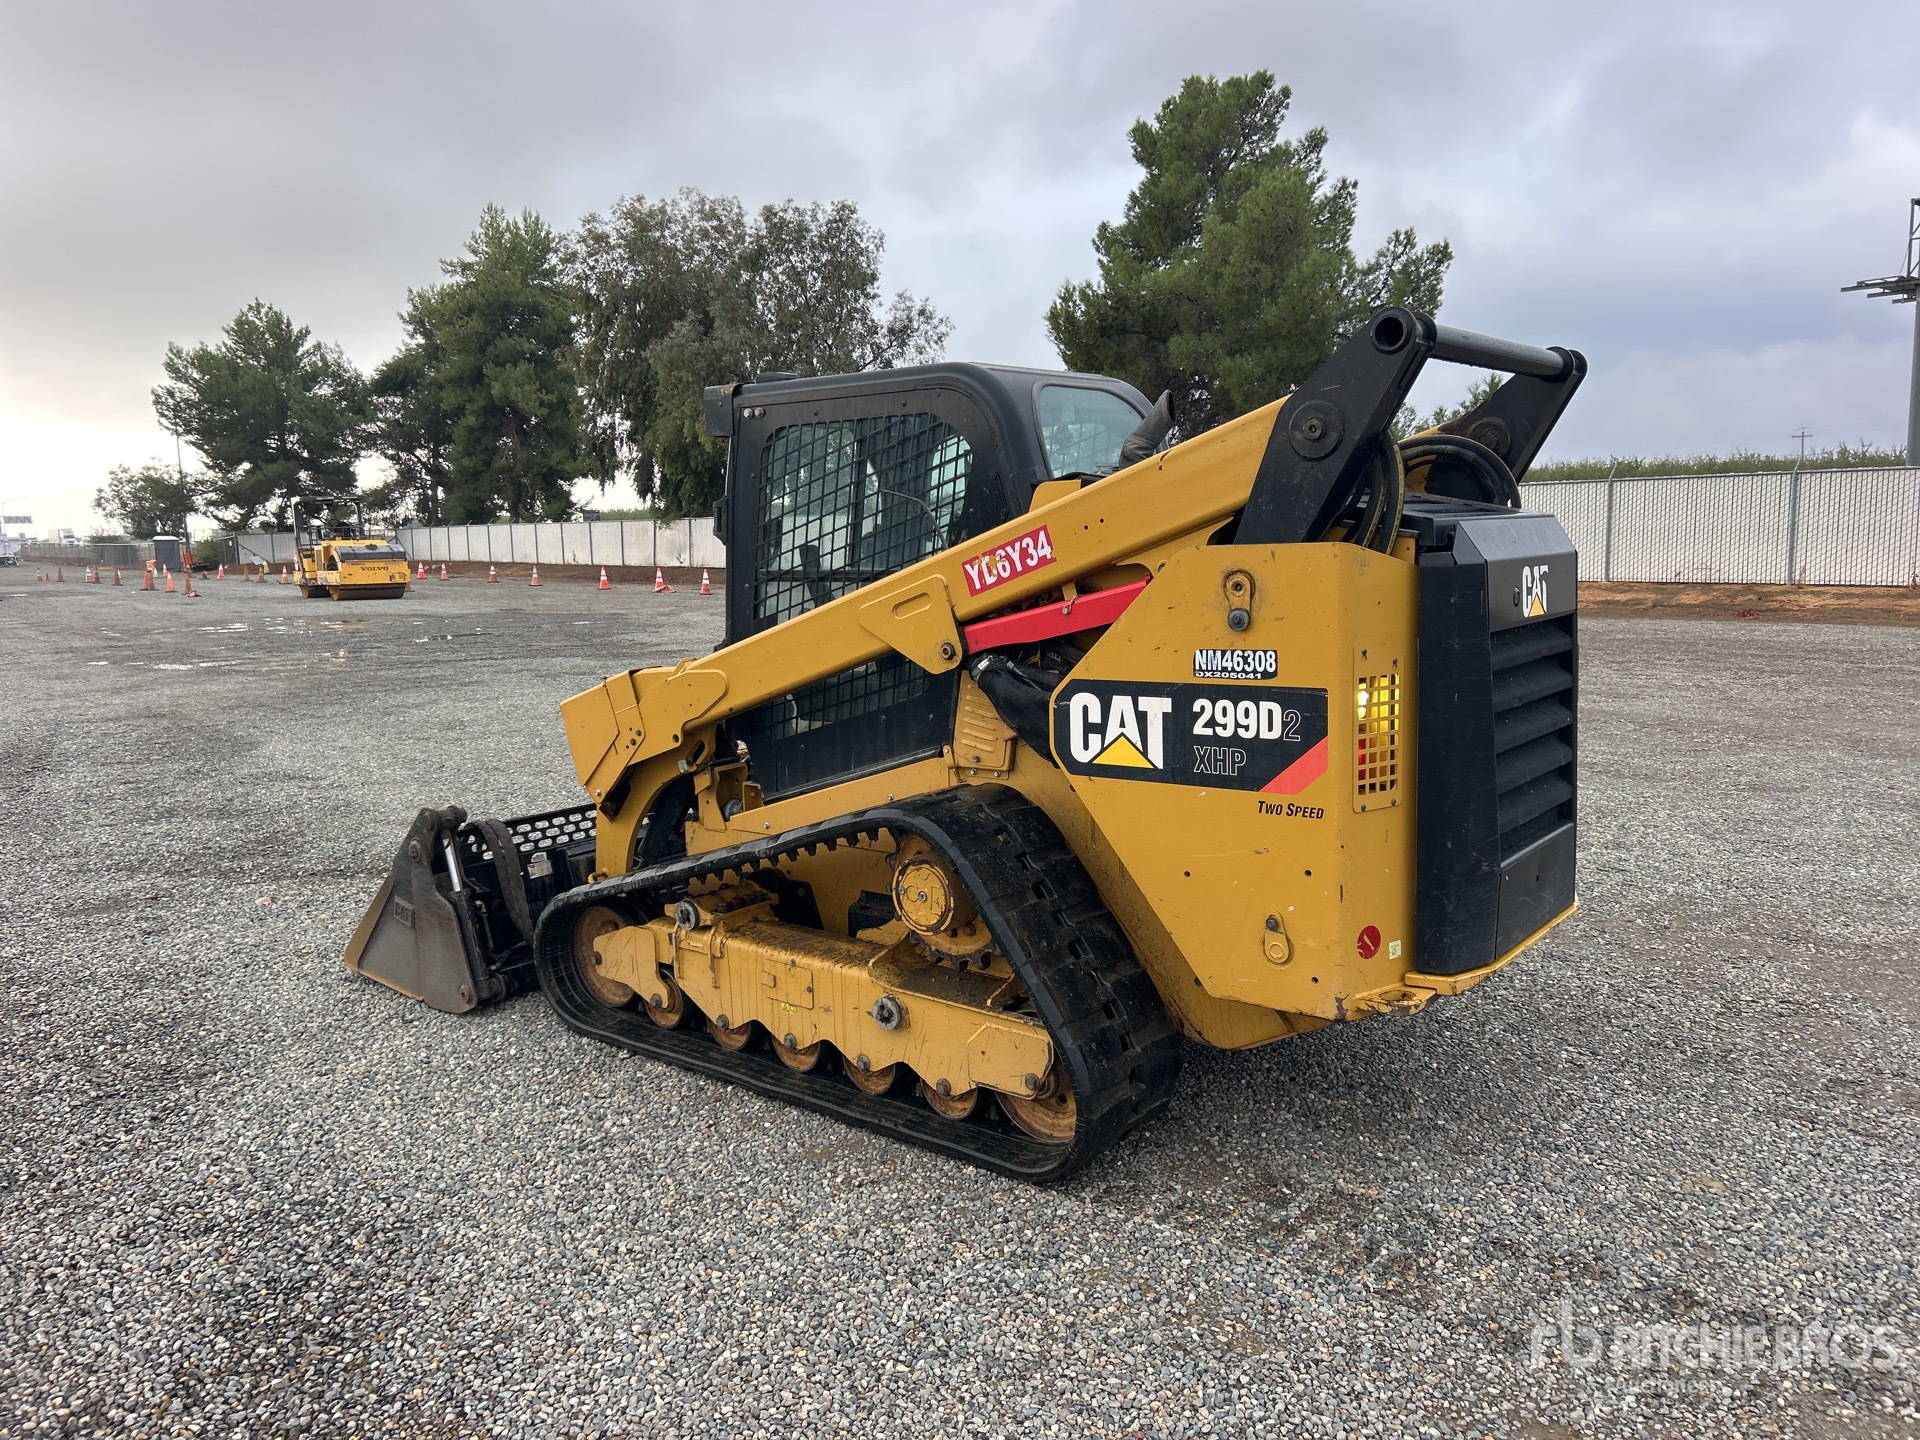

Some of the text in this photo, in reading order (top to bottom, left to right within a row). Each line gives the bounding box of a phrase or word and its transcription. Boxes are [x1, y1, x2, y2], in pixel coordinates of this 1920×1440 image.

[1522, 564, 1549, 618] CAT
[1194, 671, 1262, 679] DX205041
[1195, 649, 1277, 672] NM46308
[1069, 692, 1172, 770] CAT
[1192, 698, 1301, 742] 299D2
[1193, 745, 1247, 776] XHP
